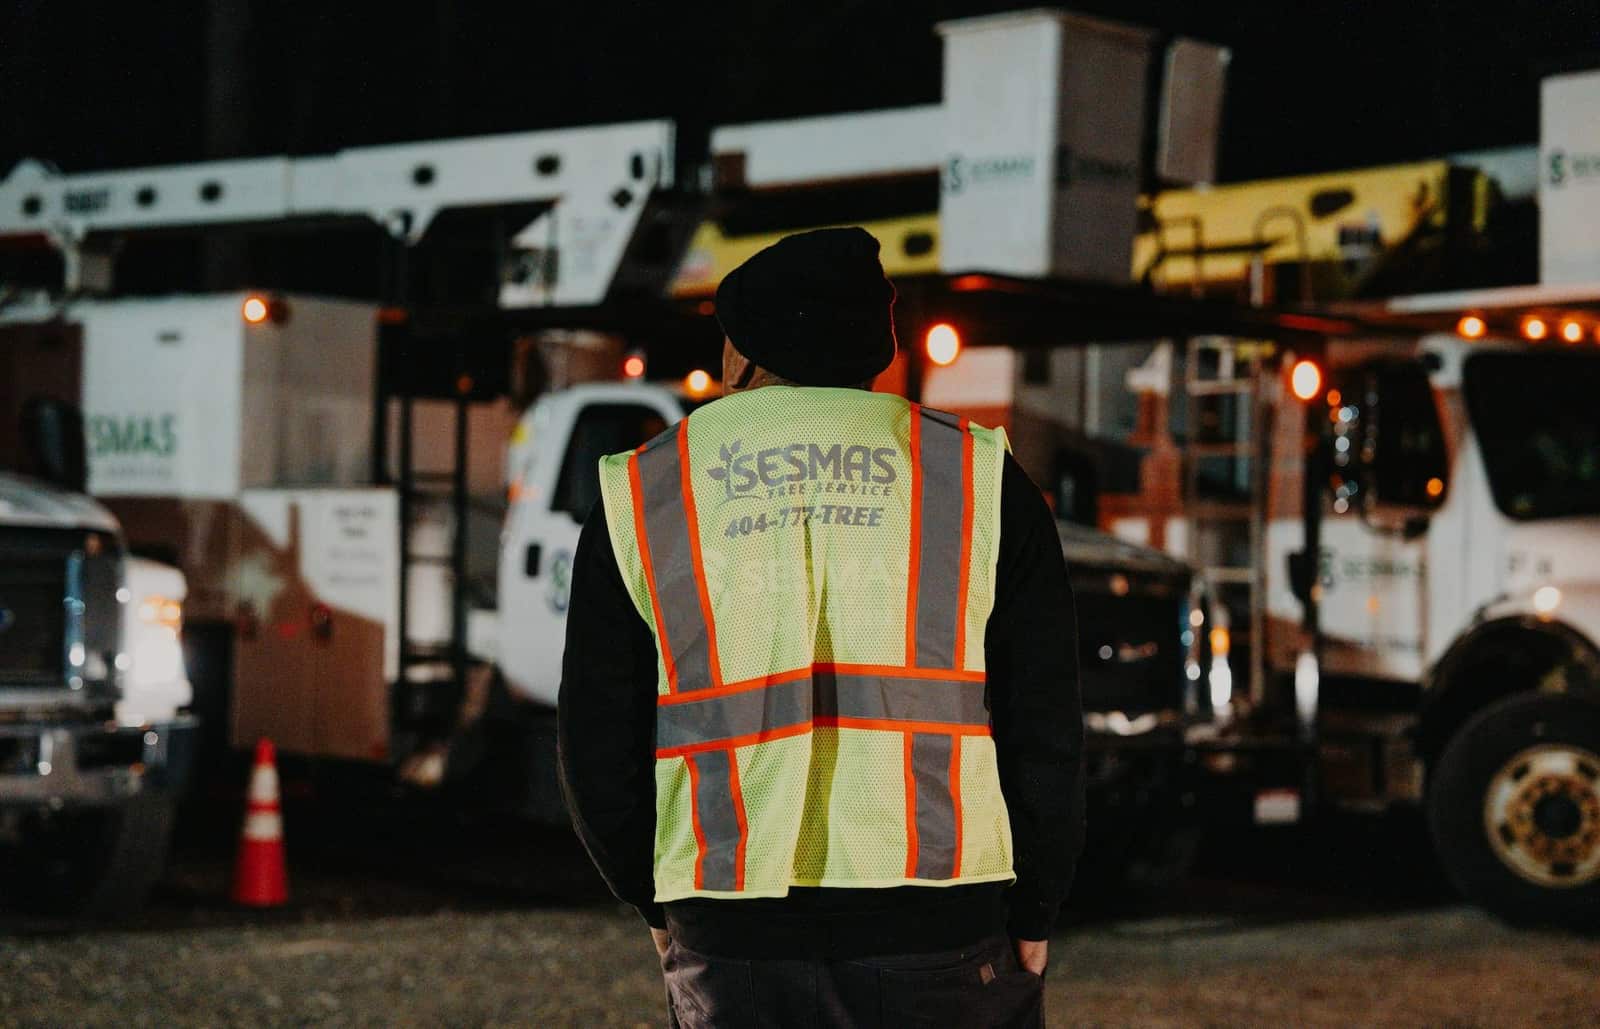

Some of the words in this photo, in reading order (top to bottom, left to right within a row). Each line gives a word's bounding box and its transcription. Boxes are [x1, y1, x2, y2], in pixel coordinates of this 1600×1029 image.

[731, 443, 898, 492] SESMAS
[768, 483, 806, 499] TREE
[815, 481, 893, 497] SERVICE
[724, 504, 885, 539] 404-777-TREE
